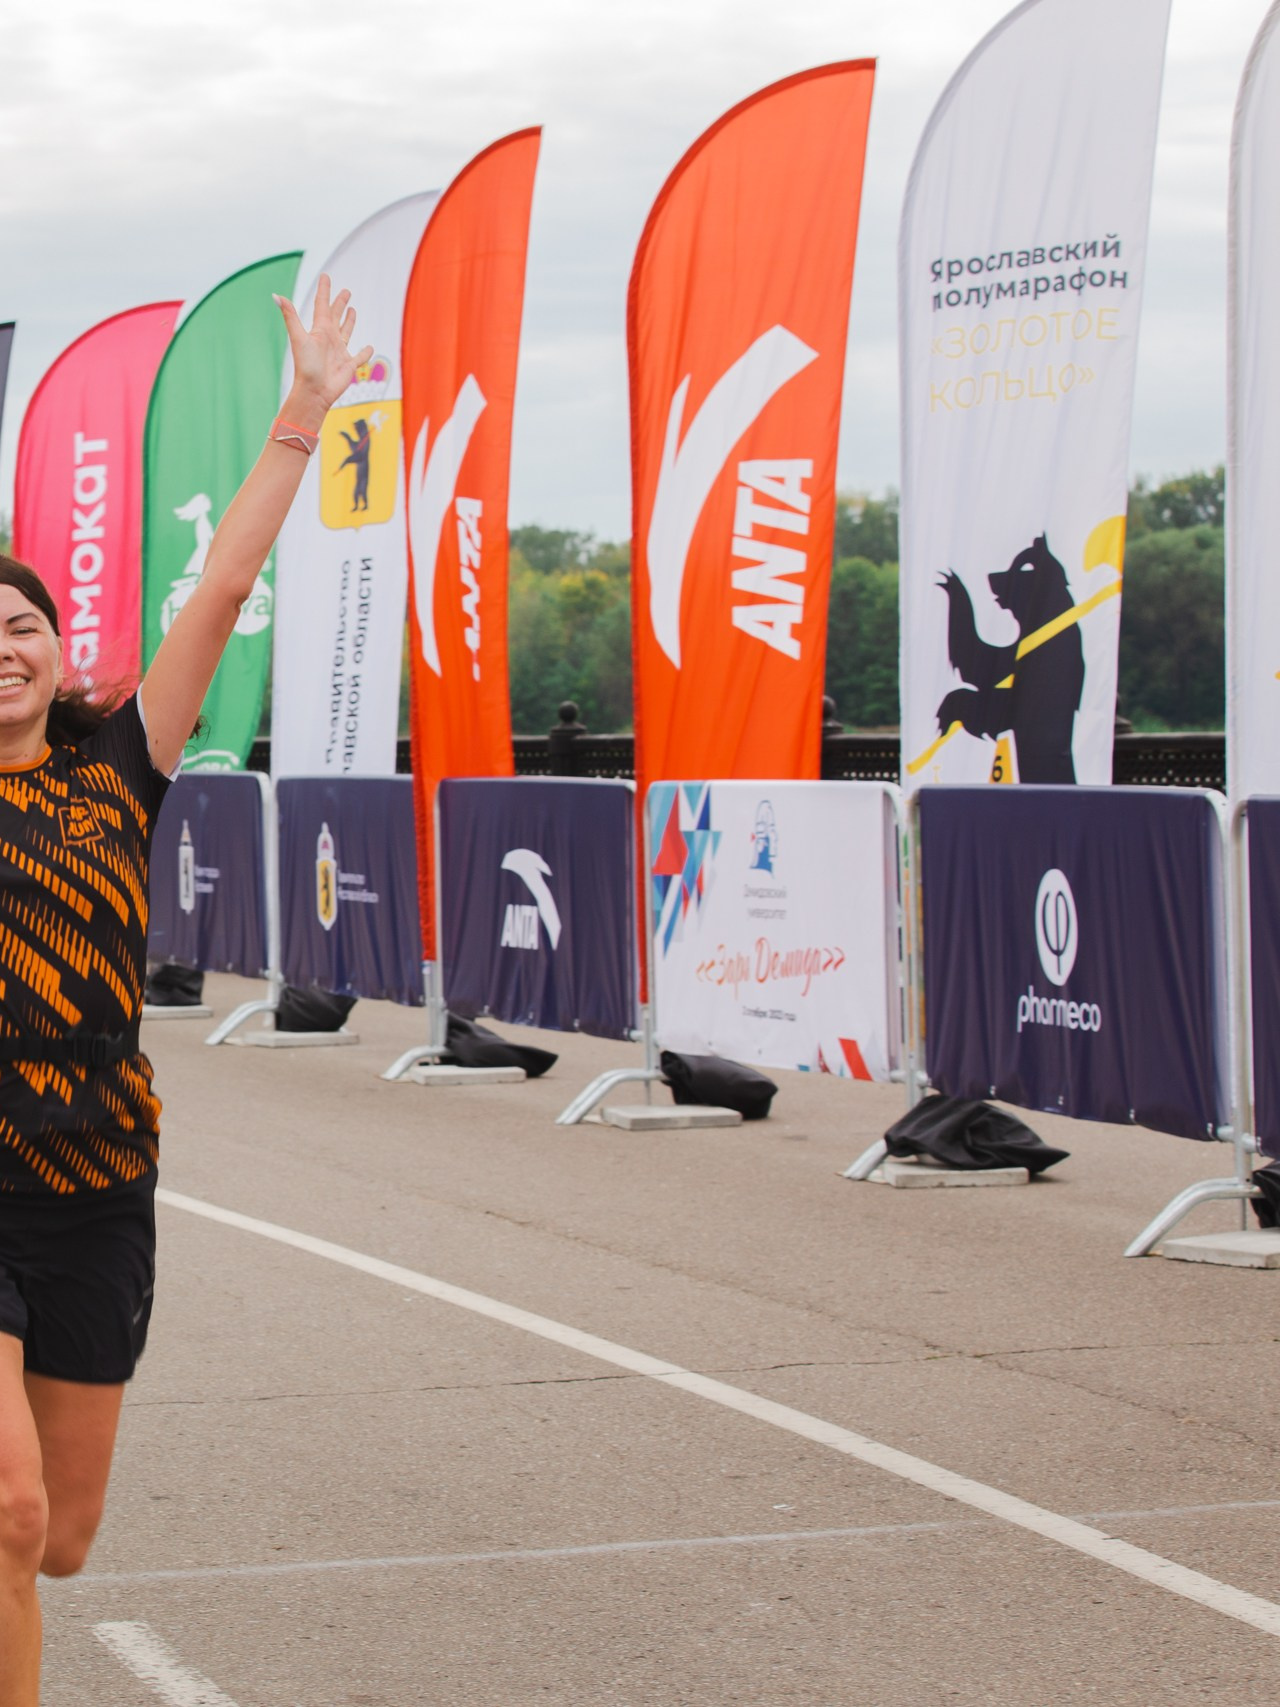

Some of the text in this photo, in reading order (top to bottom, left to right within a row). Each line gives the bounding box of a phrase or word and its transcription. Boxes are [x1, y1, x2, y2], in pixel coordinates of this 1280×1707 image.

[932, 267, 1128, 312] полумарафон
[930, 308, 1120, 359] «ЗОЛОТОЕ
[929, 363, 1096, 413] КОЛЬЦО»
[731, 458, 813, 661] ANTA
[352, 556, 373, 665] области
[500, 903, 540, 951] ANTA
